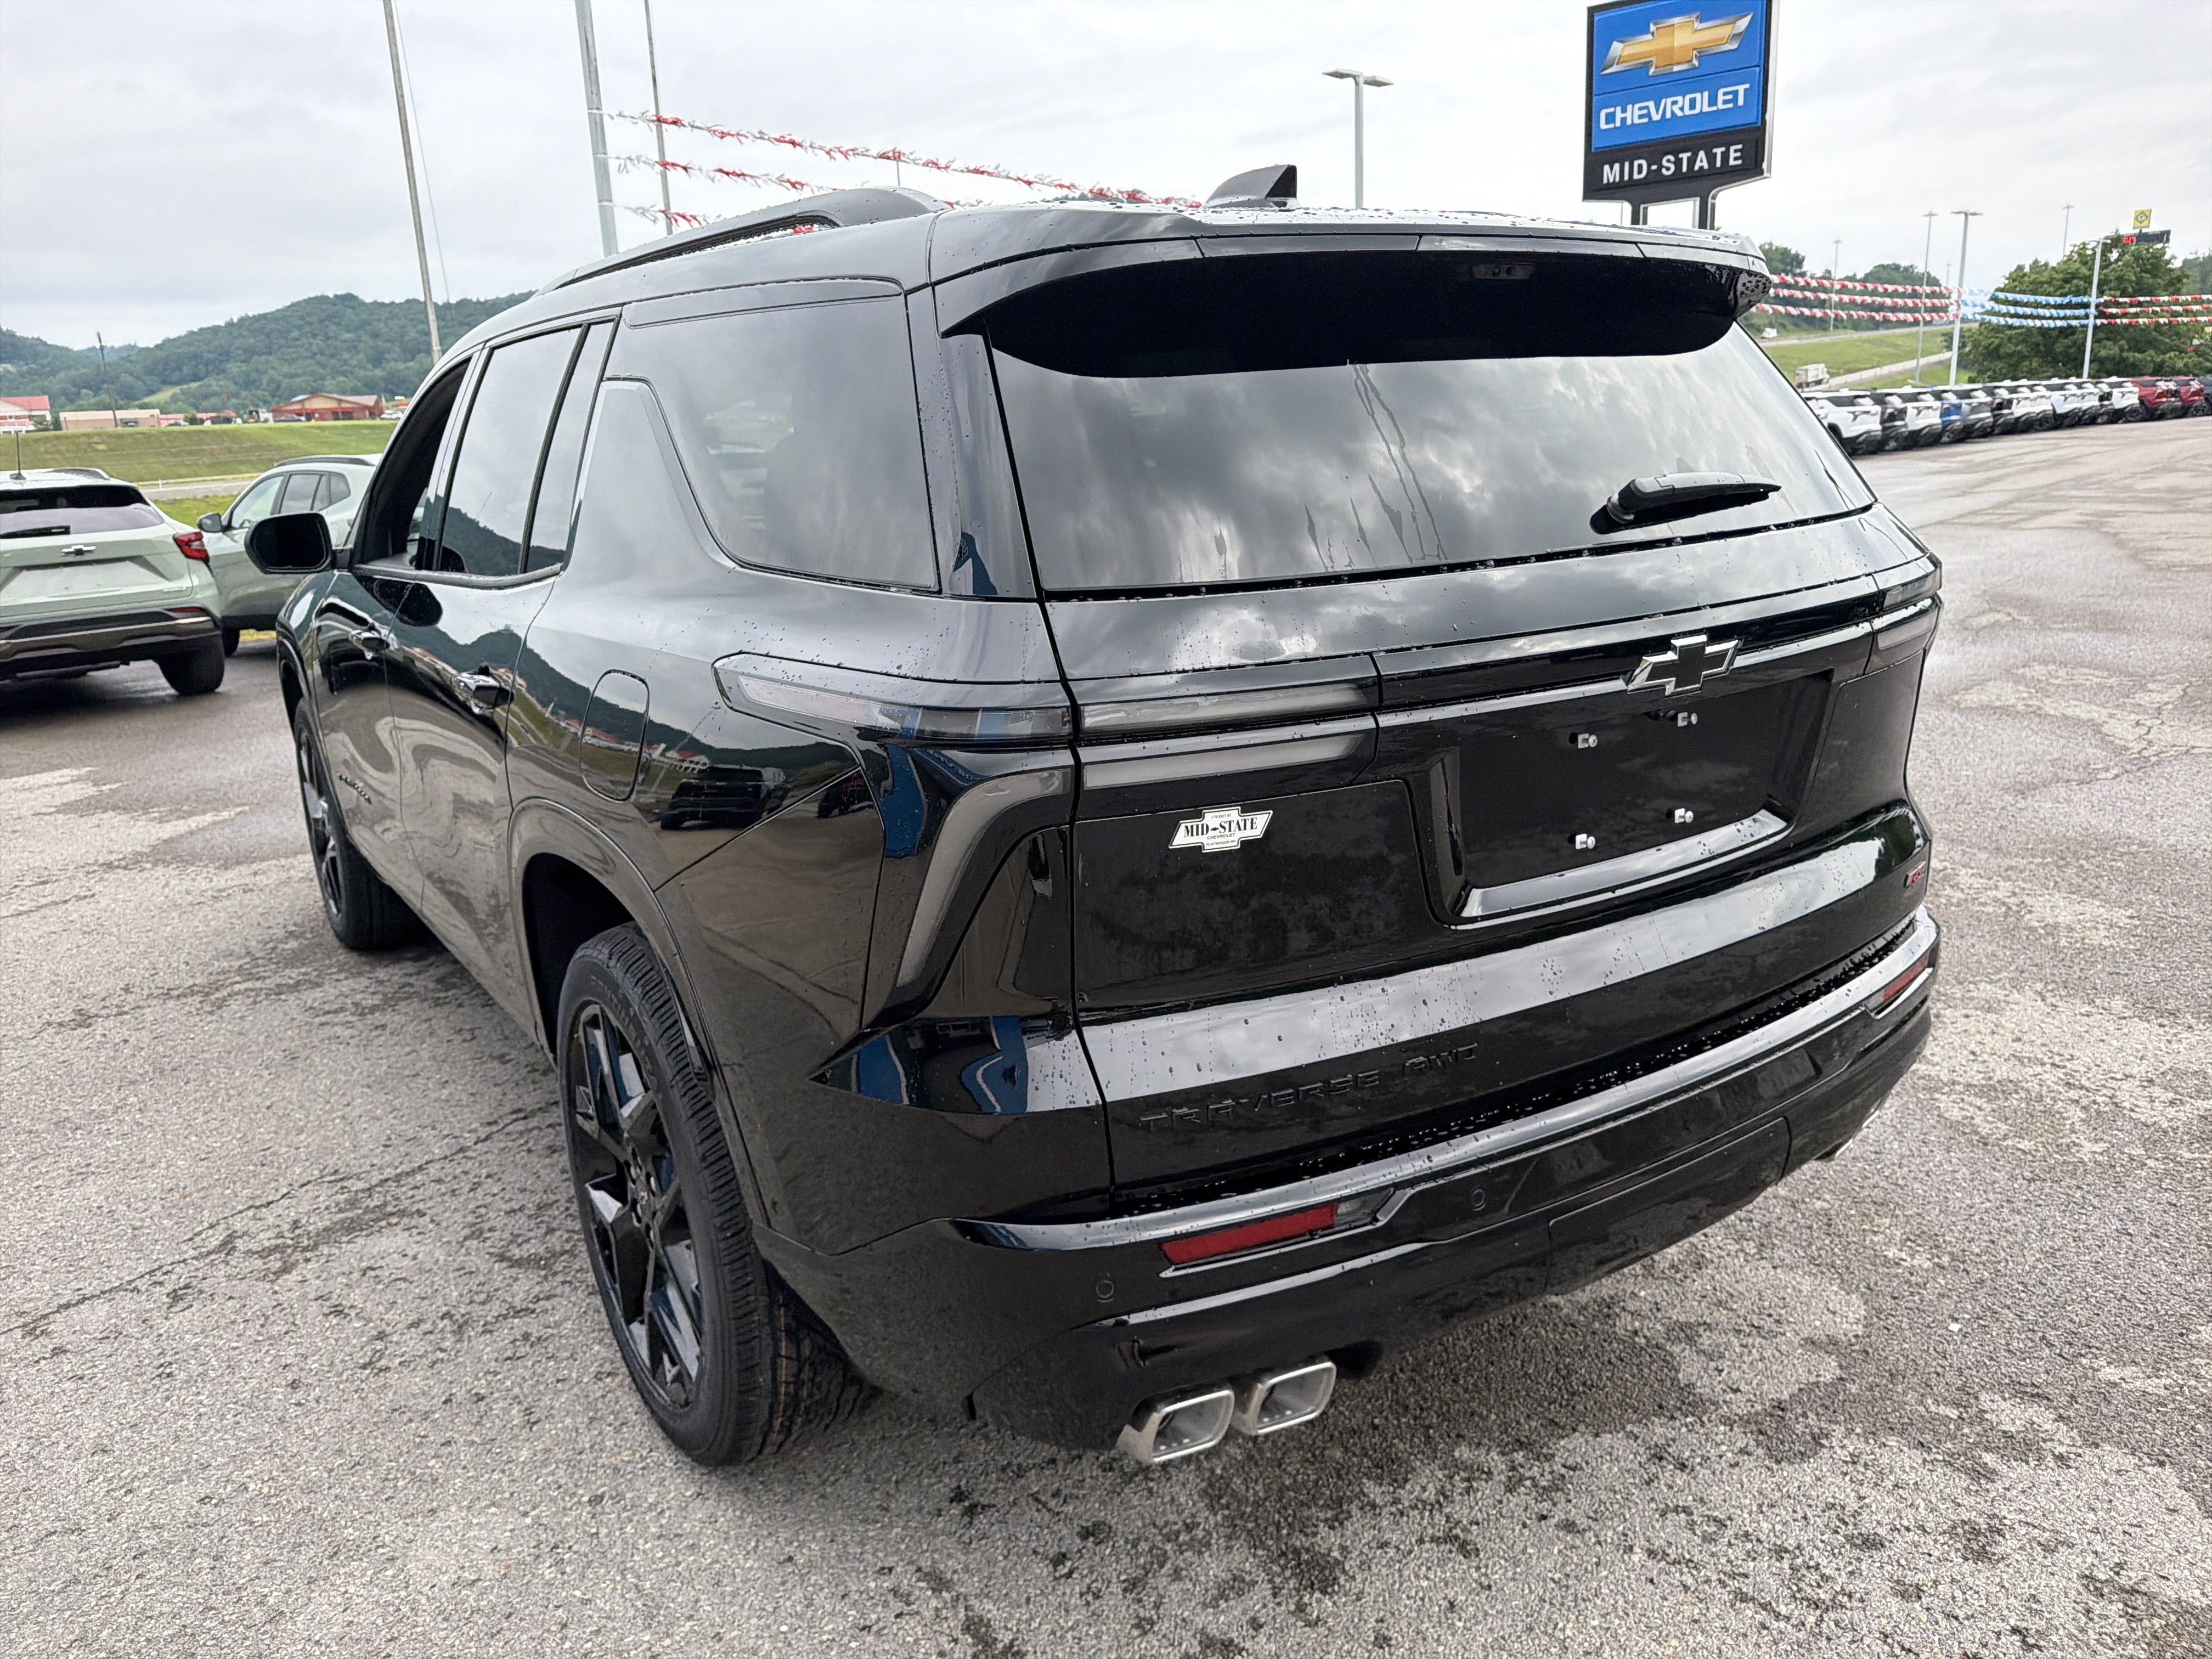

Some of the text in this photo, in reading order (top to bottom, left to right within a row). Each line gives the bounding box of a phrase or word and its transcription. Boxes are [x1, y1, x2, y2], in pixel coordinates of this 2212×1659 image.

[1599, 83, 1750, 130] CHEVROLET
[1602, 144, 1743, 184] MID-STATE
[1139, 1069, 1379, 1130] TRAVERSE
